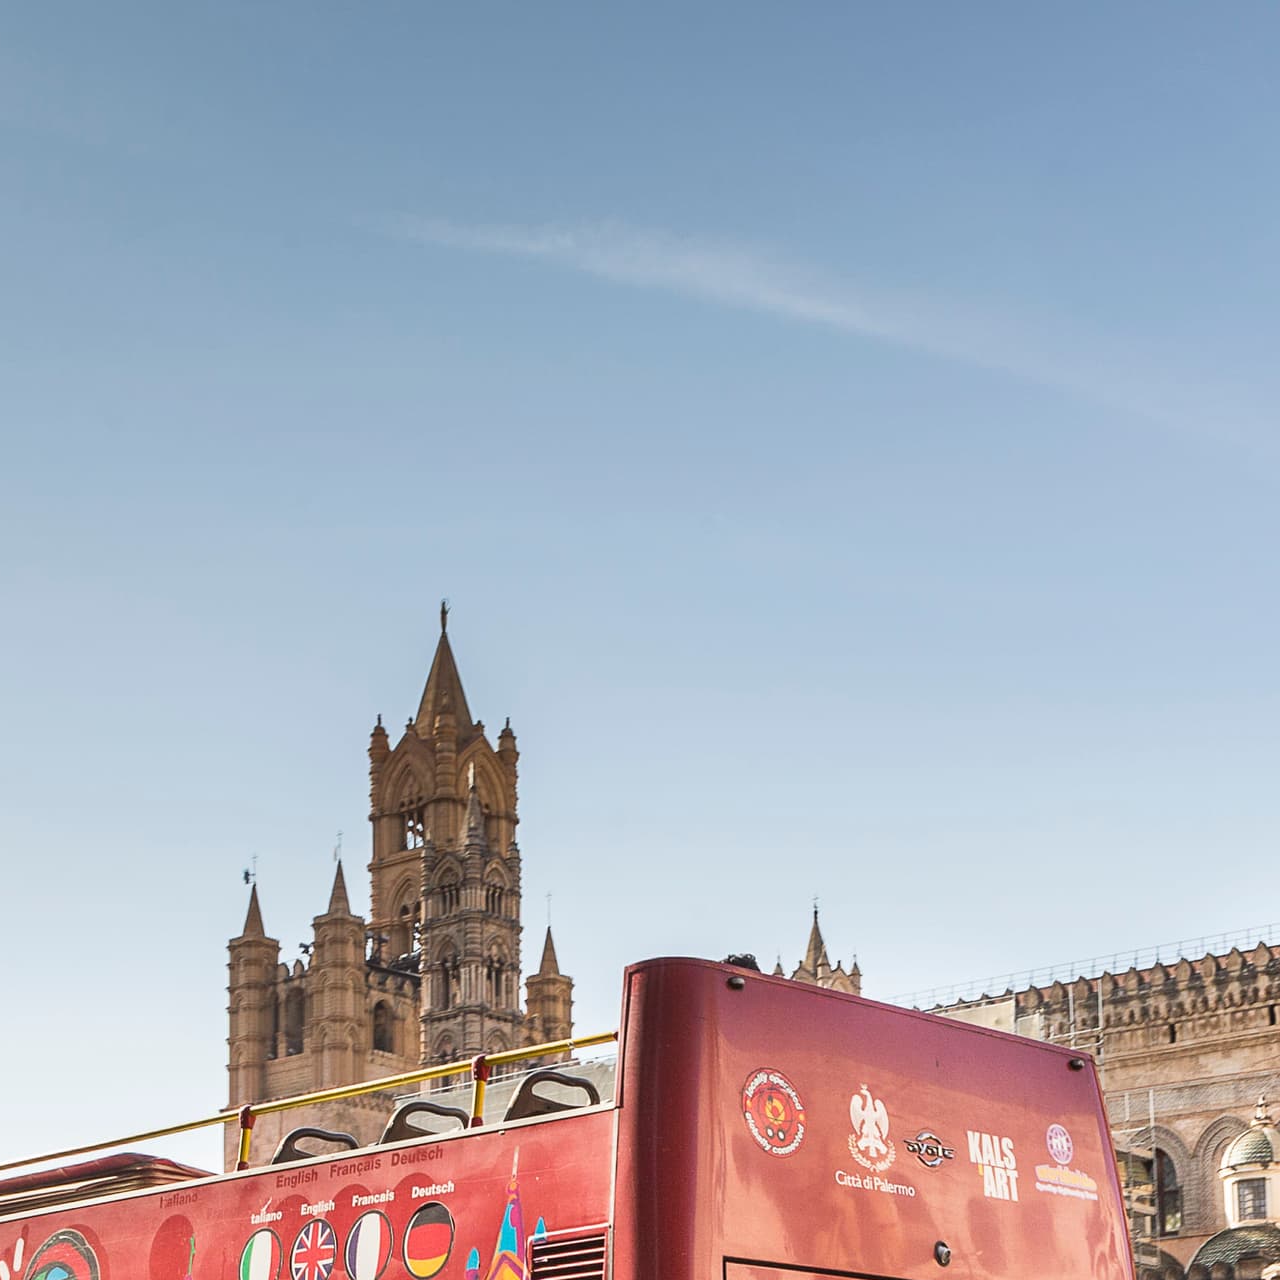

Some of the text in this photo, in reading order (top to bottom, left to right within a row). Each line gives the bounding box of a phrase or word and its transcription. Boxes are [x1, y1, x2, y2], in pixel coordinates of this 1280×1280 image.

[276, 1169, 318, 1188] English
[330, 1156, 381, 1178] Français
[391, 1146, 443, 1167] Deutsch
[967, 1130, 1017, 1170] KALS
[301, 1200, 335, 1216] English
[411, 1180, 455, 1199] Deutsch
[835, 1170, 916, 1198] Città di Palermo
